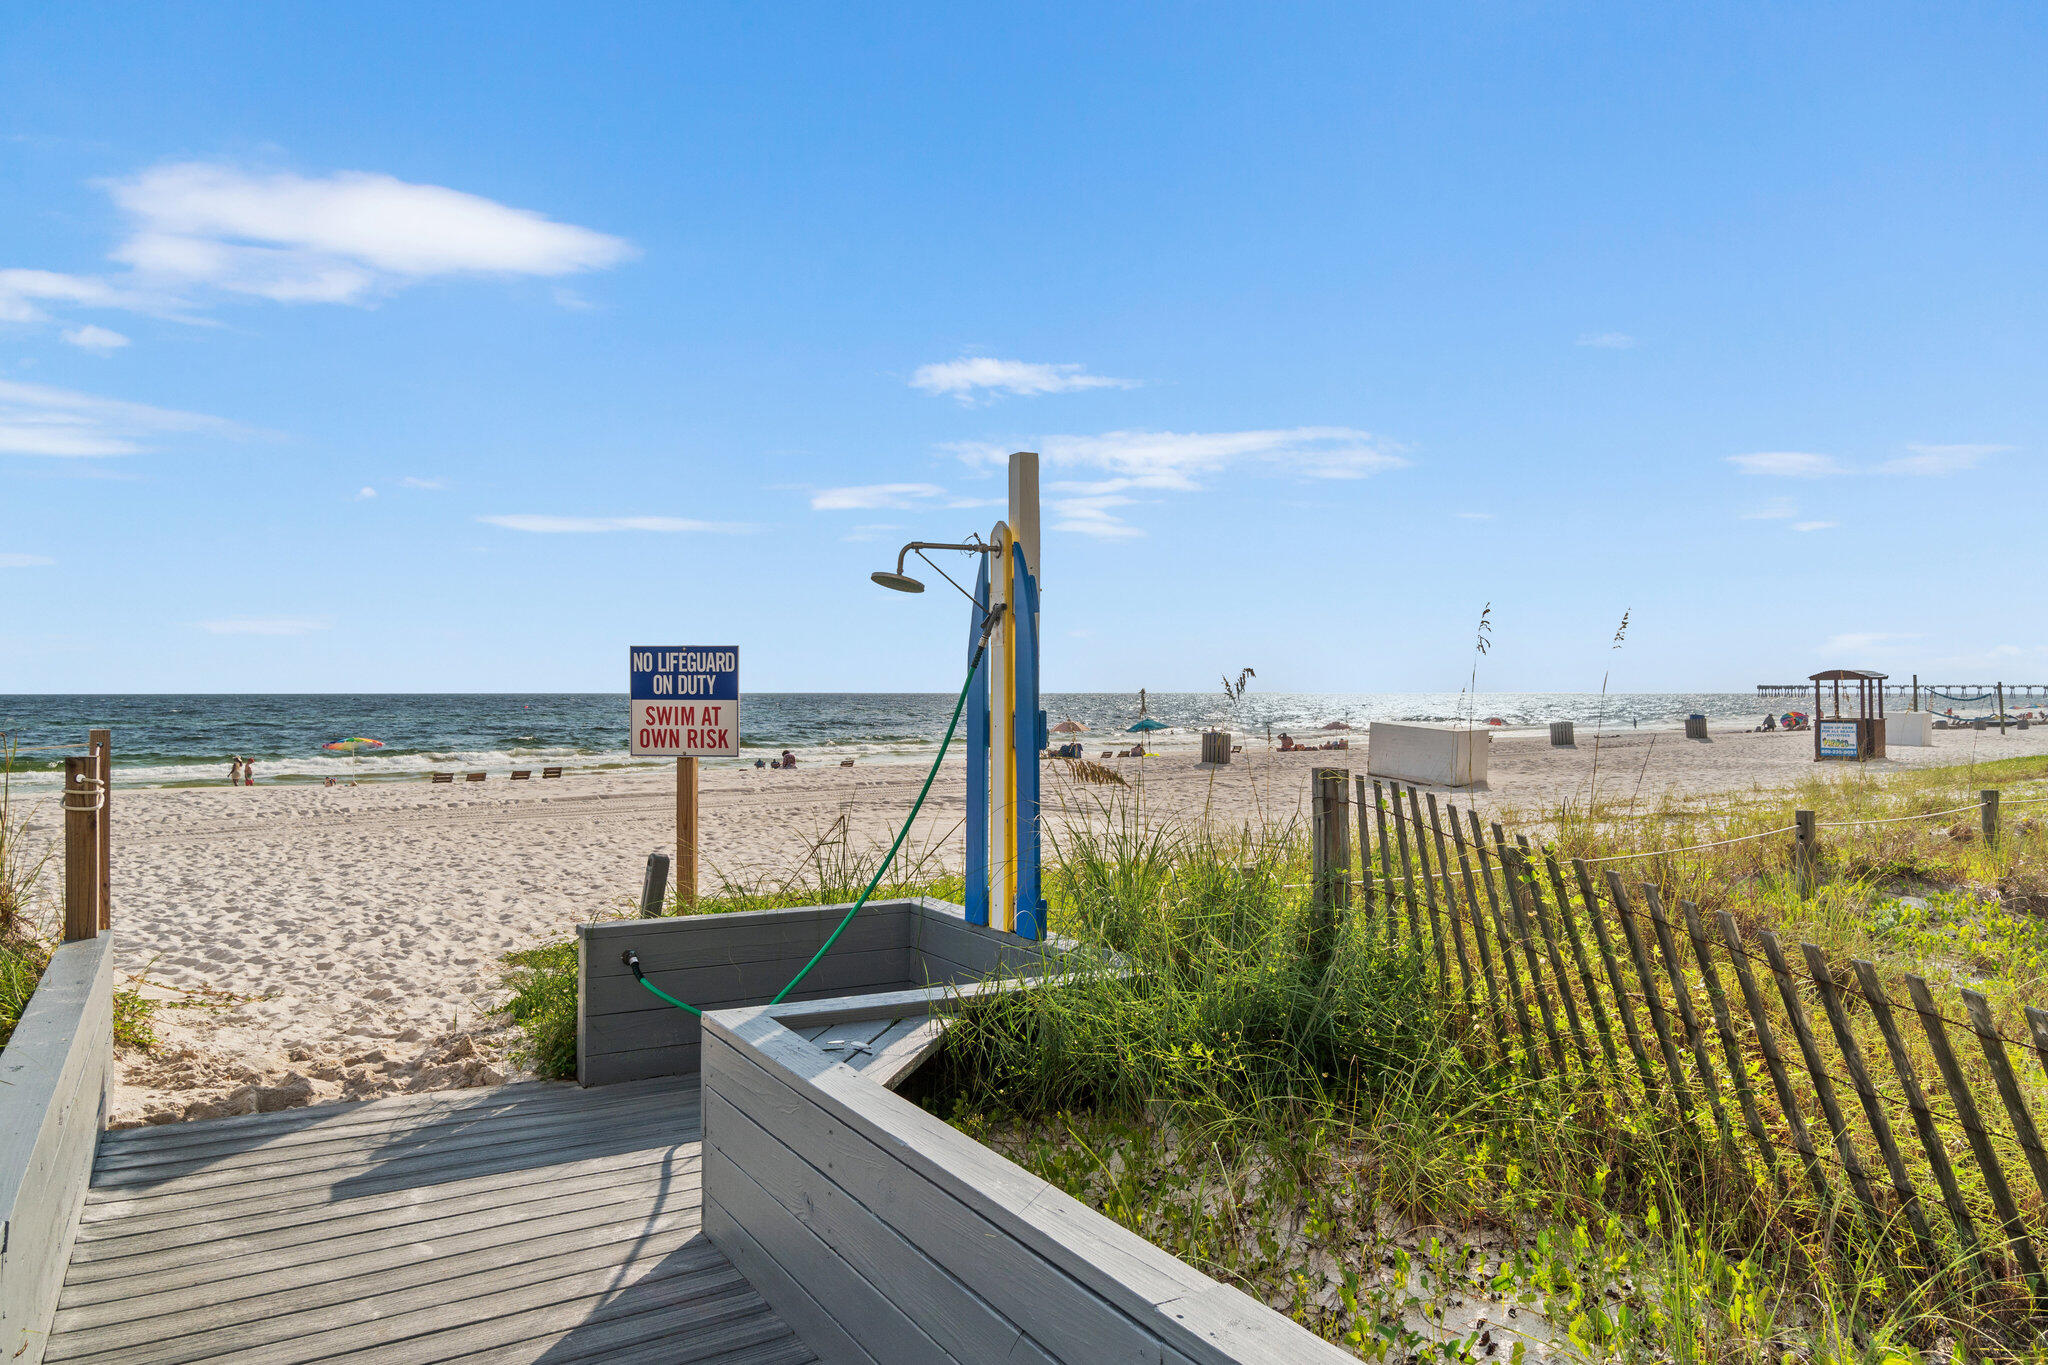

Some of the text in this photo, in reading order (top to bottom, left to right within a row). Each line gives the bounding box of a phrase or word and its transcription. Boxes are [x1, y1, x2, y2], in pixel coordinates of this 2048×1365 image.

[633, 652, 735, 672] NO LIFEGUARD
[653, 675, 716, 695] ON DUTY
[645, 706, 721, 726] SWIM AT
[640, 728, 729, 749] OWN RISK
